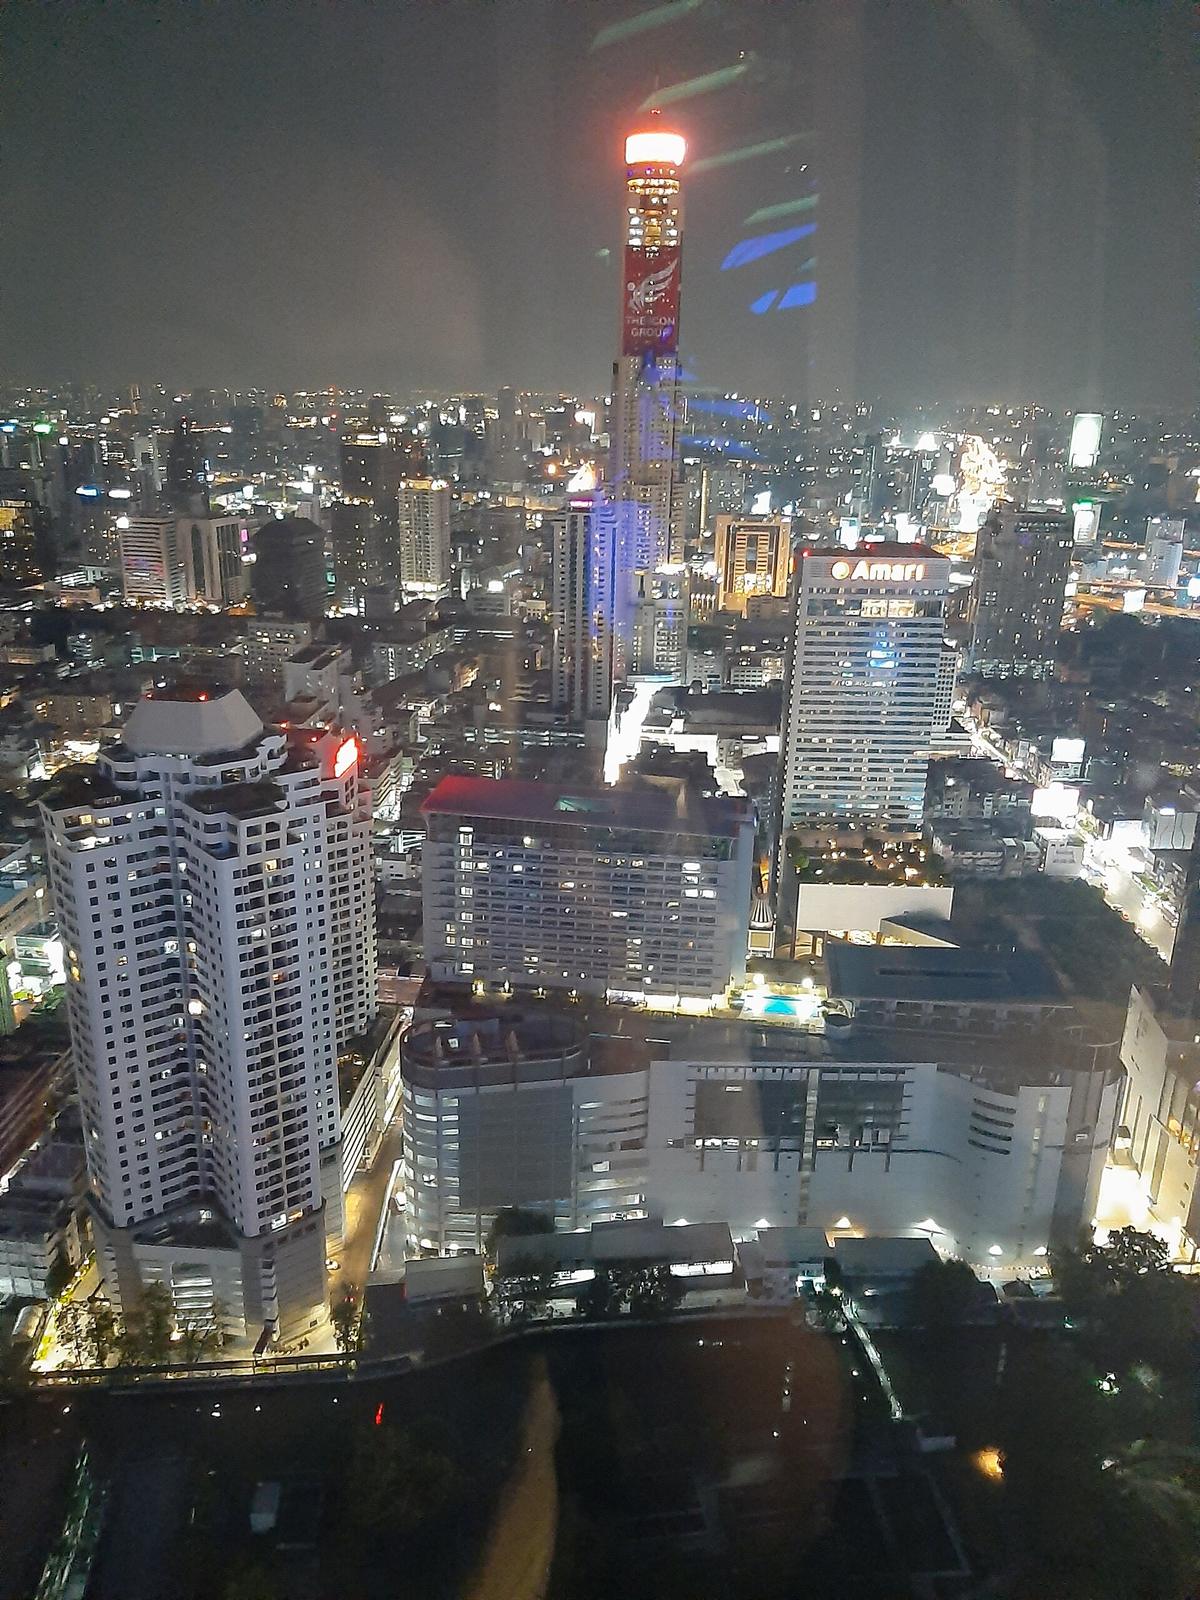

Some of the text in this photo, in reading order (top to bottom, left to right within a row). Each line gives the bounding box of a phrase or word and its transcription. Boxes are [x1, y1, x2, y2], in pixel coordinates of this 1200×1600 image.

[625, 316, 675, 326] THE CON
[631, 328, 671, 337] GROUP
[851, 560, 924, 582] Amari
